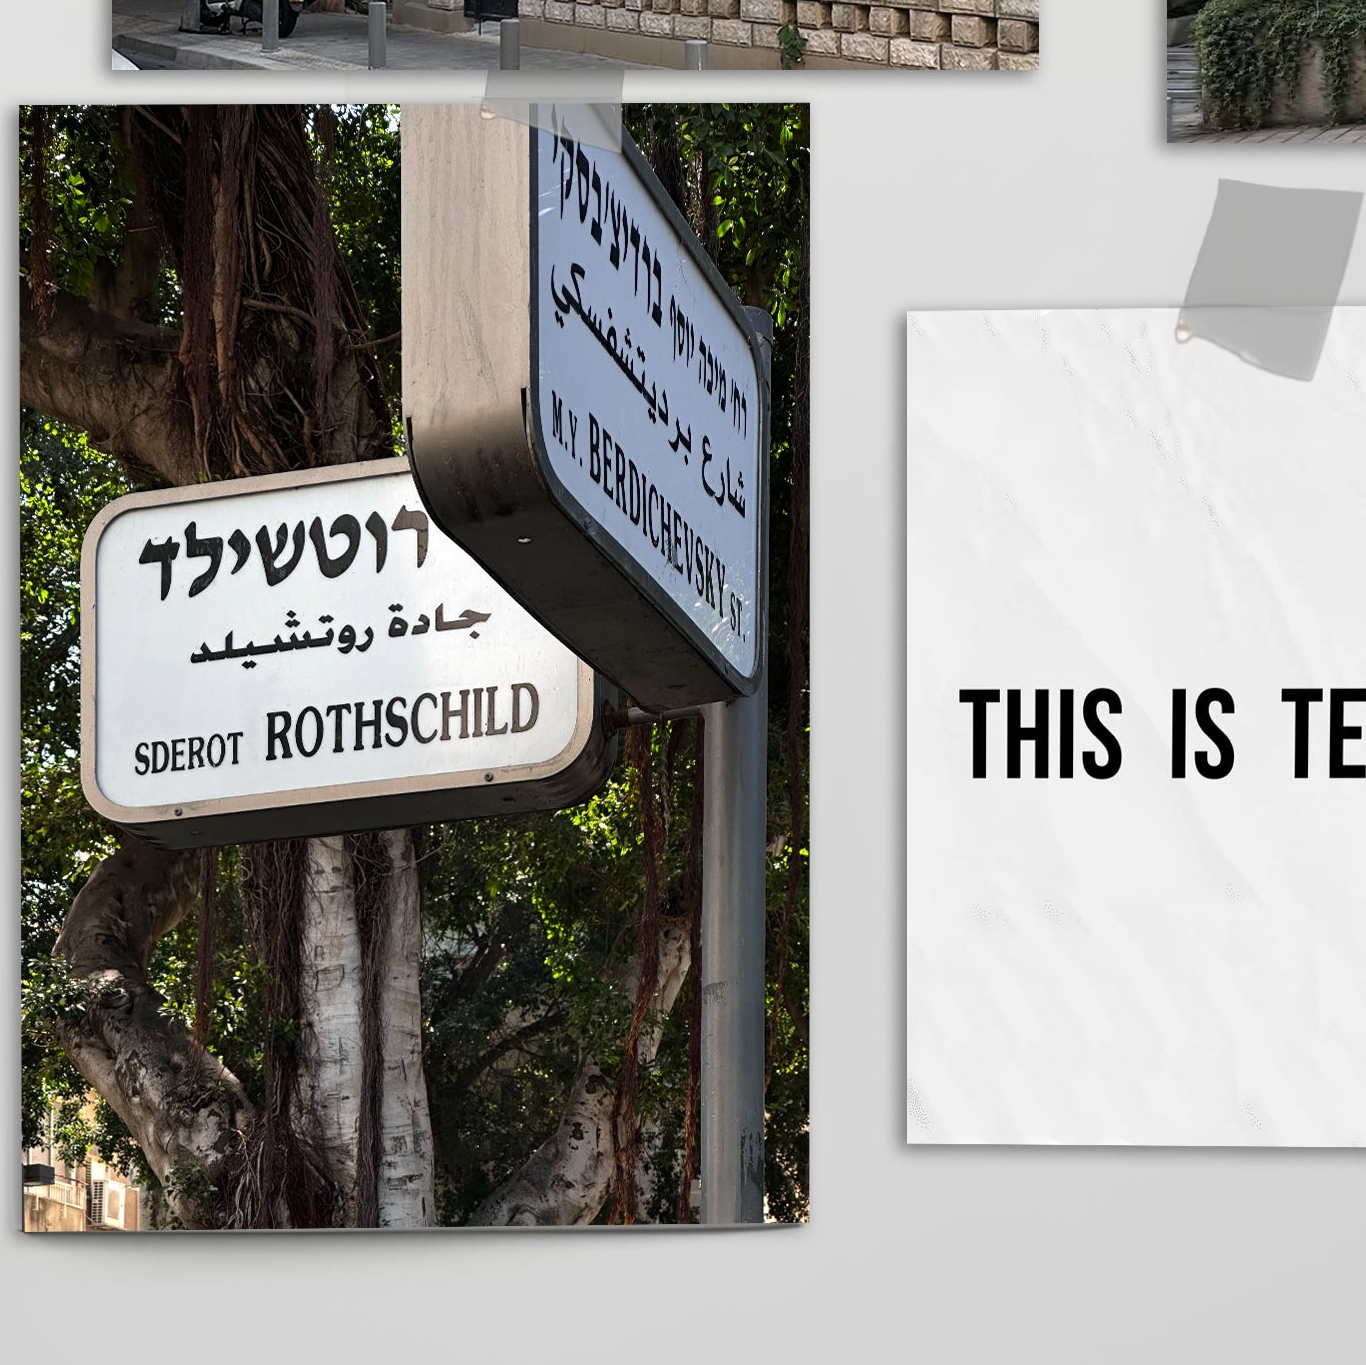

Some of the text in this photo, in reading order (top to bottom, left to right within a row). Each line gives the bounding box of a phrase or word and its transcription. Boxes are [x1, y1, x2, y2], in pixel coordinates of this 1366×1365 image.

[670, 293, 695, 368] יוסף
[698, 334, 727, 414] מיכה
[552, 389, 746, 643] M.Y. BERDICHEVSKY ST.
[701, 435, 746, 519] شارع
[138, 504, 430, 603] רוטשילד
[190, 603, 492, 670] جادة روتشيلد
[134, 682, 540, 776] SDEROT ROTHSCHILD
[959, 687, 1123, 780] THIS
[1171, 687, 1235, 780] IS
